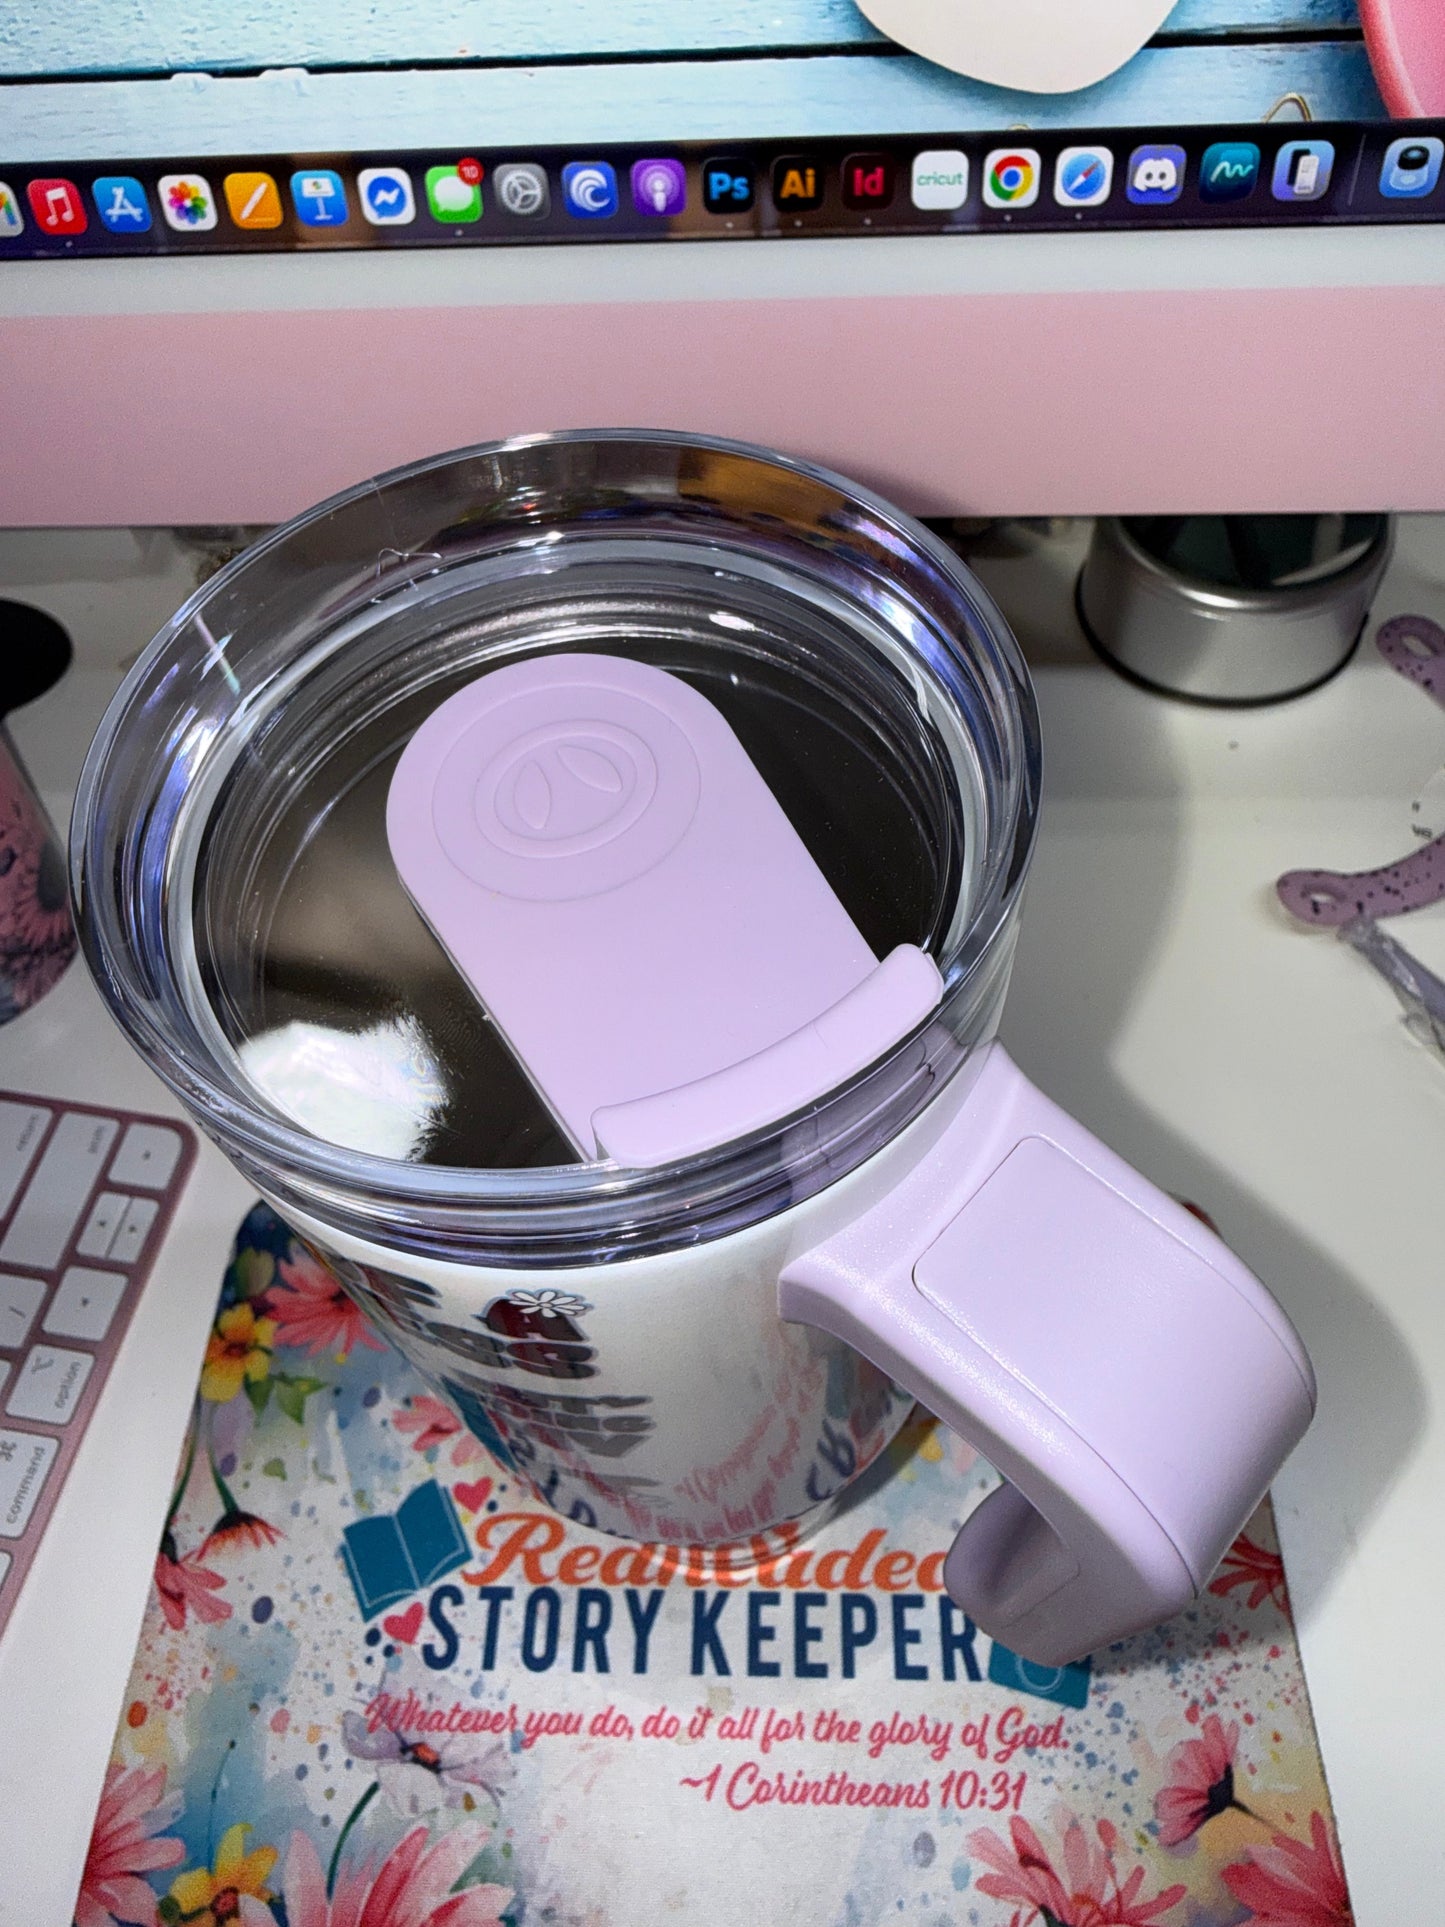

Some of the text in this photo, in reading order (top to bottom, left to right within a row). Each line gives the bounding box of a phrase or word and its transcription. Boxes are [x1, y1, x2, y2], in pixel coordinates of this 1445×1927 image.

[708, 171, 750, 200] Ps
[779, 166, 817, 199] Ai
[852, 166, 885, 197] Id
[916, 171, 963, 187] cricut
[54, 1361, 81, 1409] option
[6, 1446, 45, 1524] command
[422, 1584, 983, 1682] STORY KEEPER
[364, 1687, 1070, 1764] Whatever you do, do it all for the glory of God.
[940, 1769, 1028, 1812] 10:31
